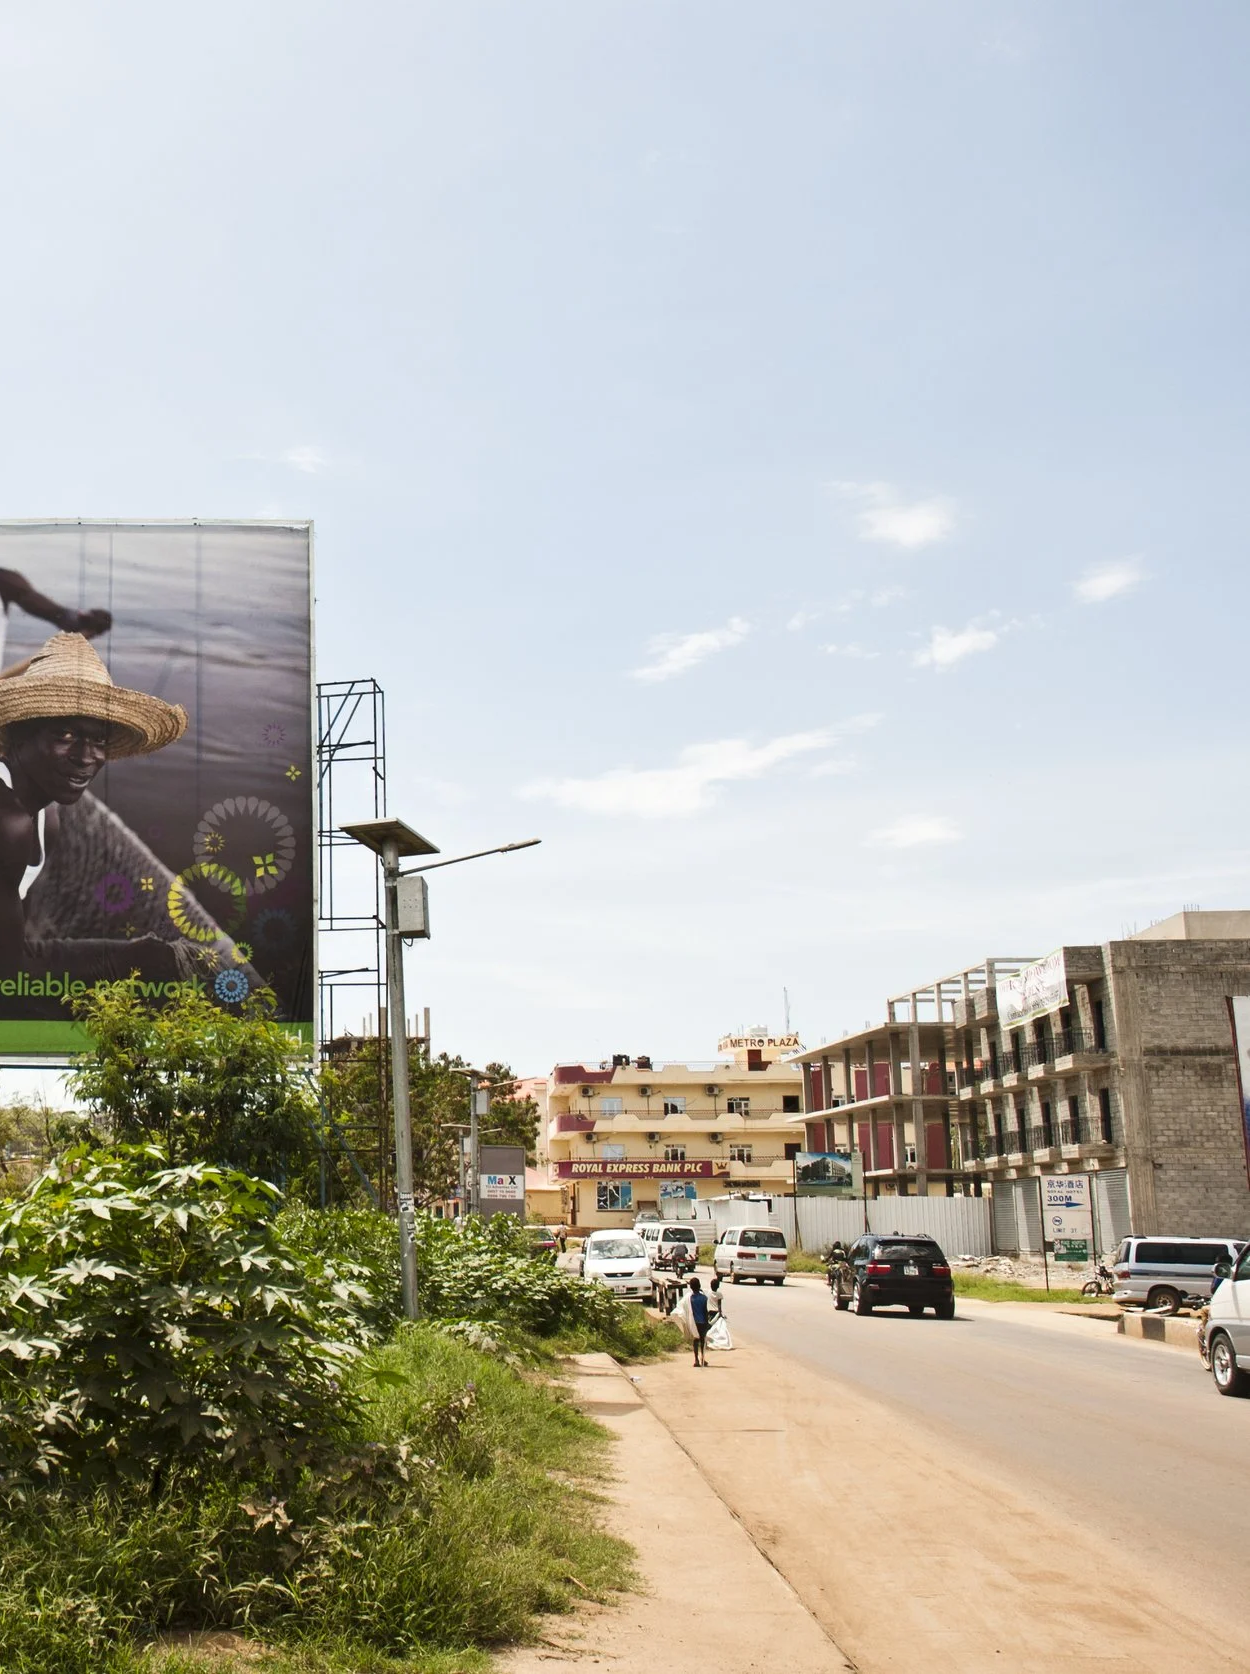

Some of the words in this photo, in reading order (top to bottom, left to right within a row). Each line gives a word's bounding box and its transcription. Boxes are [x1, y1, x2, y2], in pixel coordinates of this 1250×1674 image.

[94, 973, 207, 998] ntwork
[730, 1038, 764, 1048] METRO
[767, 1037, 800, 1047] PLAZA
[571, 1163, 603, 1173] ROYAL
[606, 1163, 650, 1173] EXPRESS
[652, 1163, 681, 1173] BANK
[684, 1163, 703, 1173] PLC
